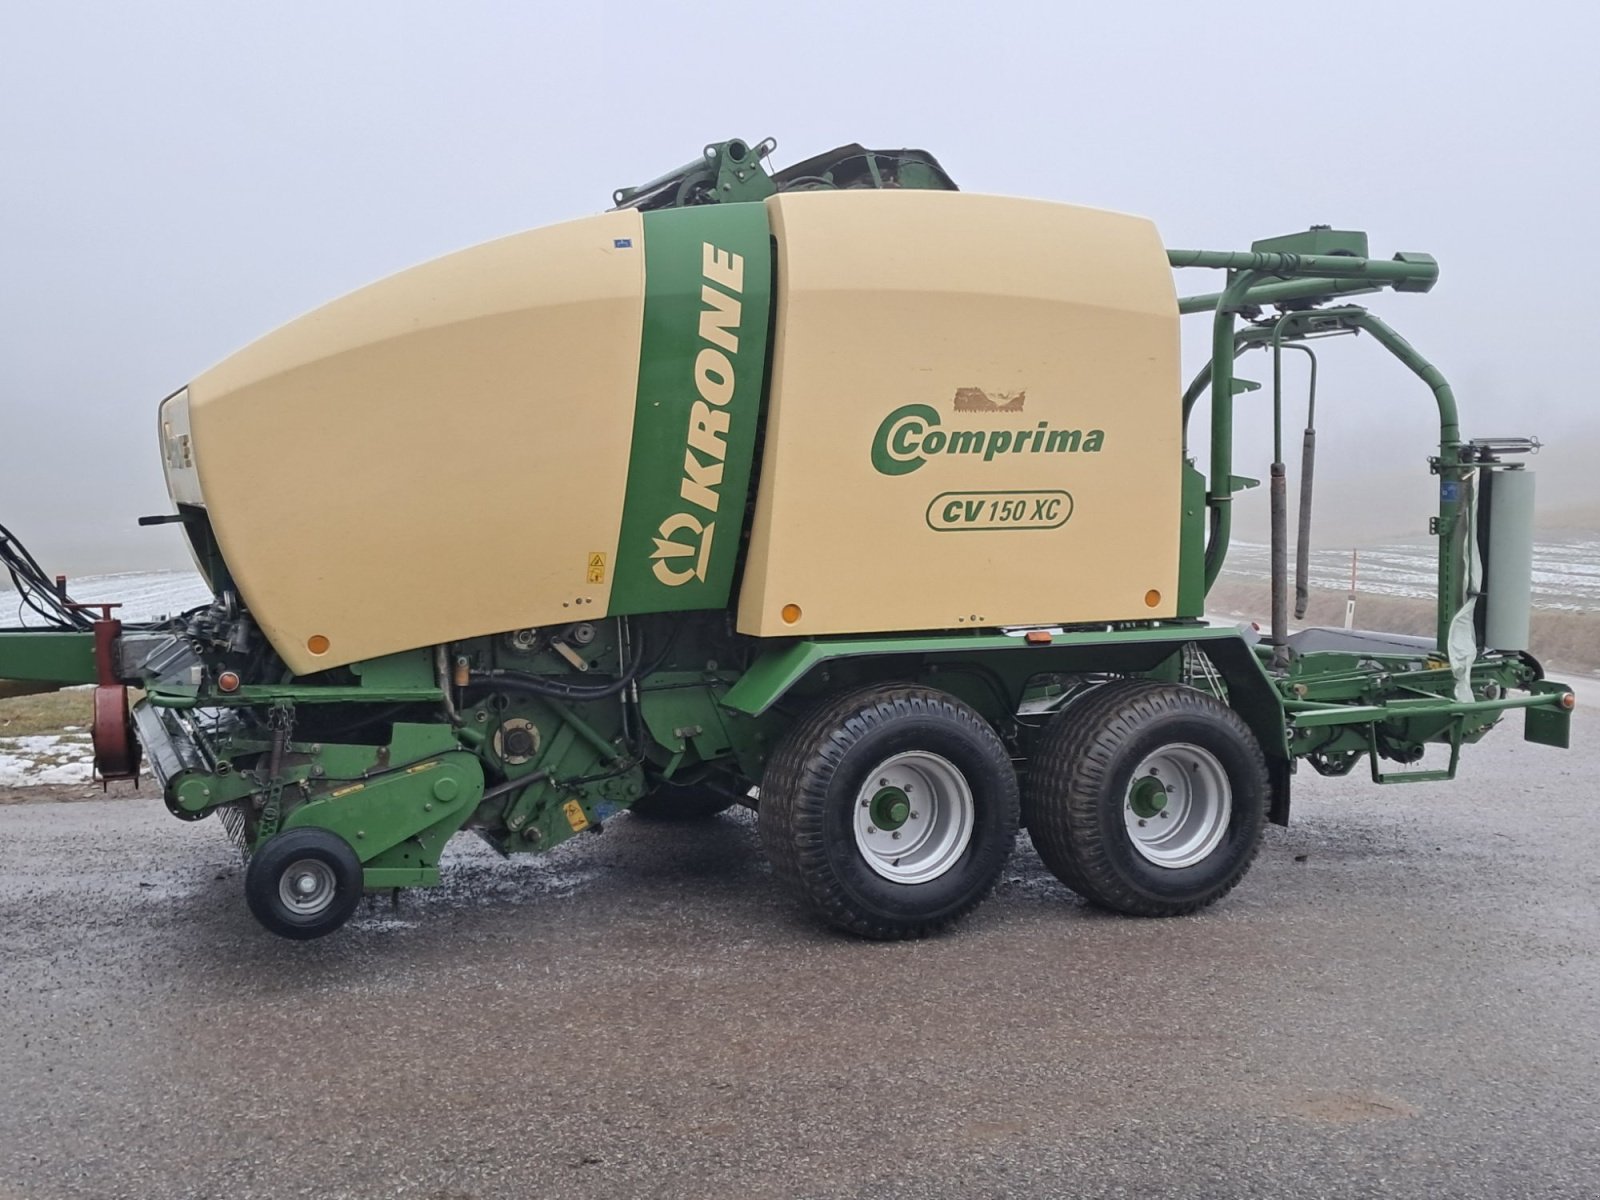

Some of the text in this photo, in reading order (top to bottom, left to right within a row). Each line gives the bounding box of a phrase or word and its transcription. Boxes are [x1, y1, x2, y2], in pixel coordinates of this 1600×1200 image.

[680, 241, 744, 512] KRONE
[942, 498, 1061, 523] CV 150 XC
